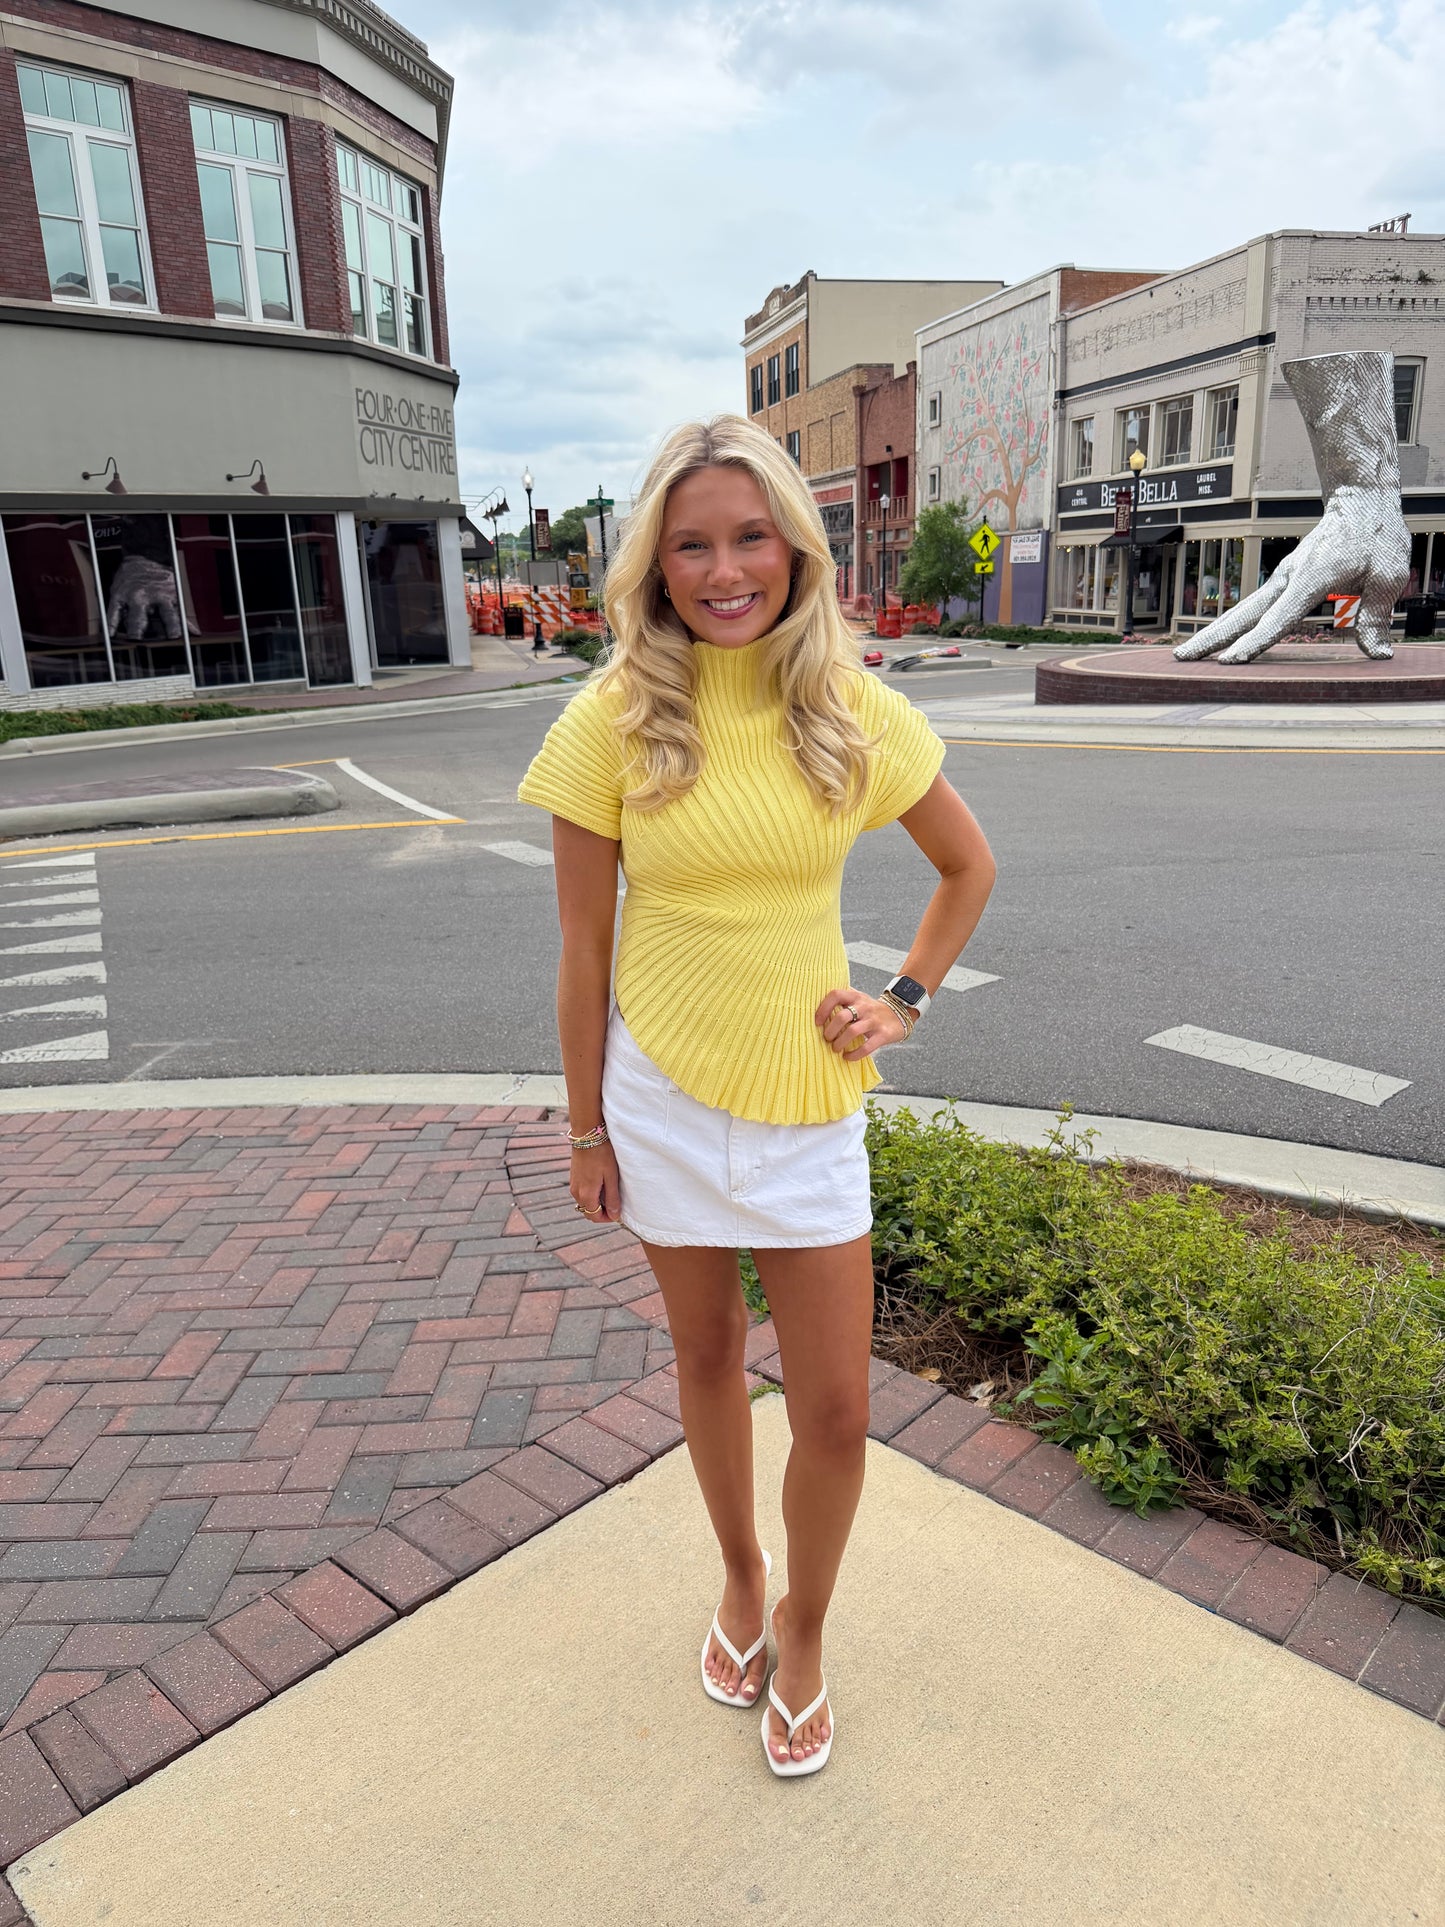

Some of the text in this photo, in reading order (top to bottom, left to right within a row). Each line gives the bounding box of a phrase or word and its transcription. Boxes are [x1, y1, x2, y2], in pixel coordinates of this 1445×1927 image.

[360, 426, 455, 475] CITY CENTRE
[1196, 472, 1217, 484] LAUREL
[1138, 479, 1178, 504] BELLA
